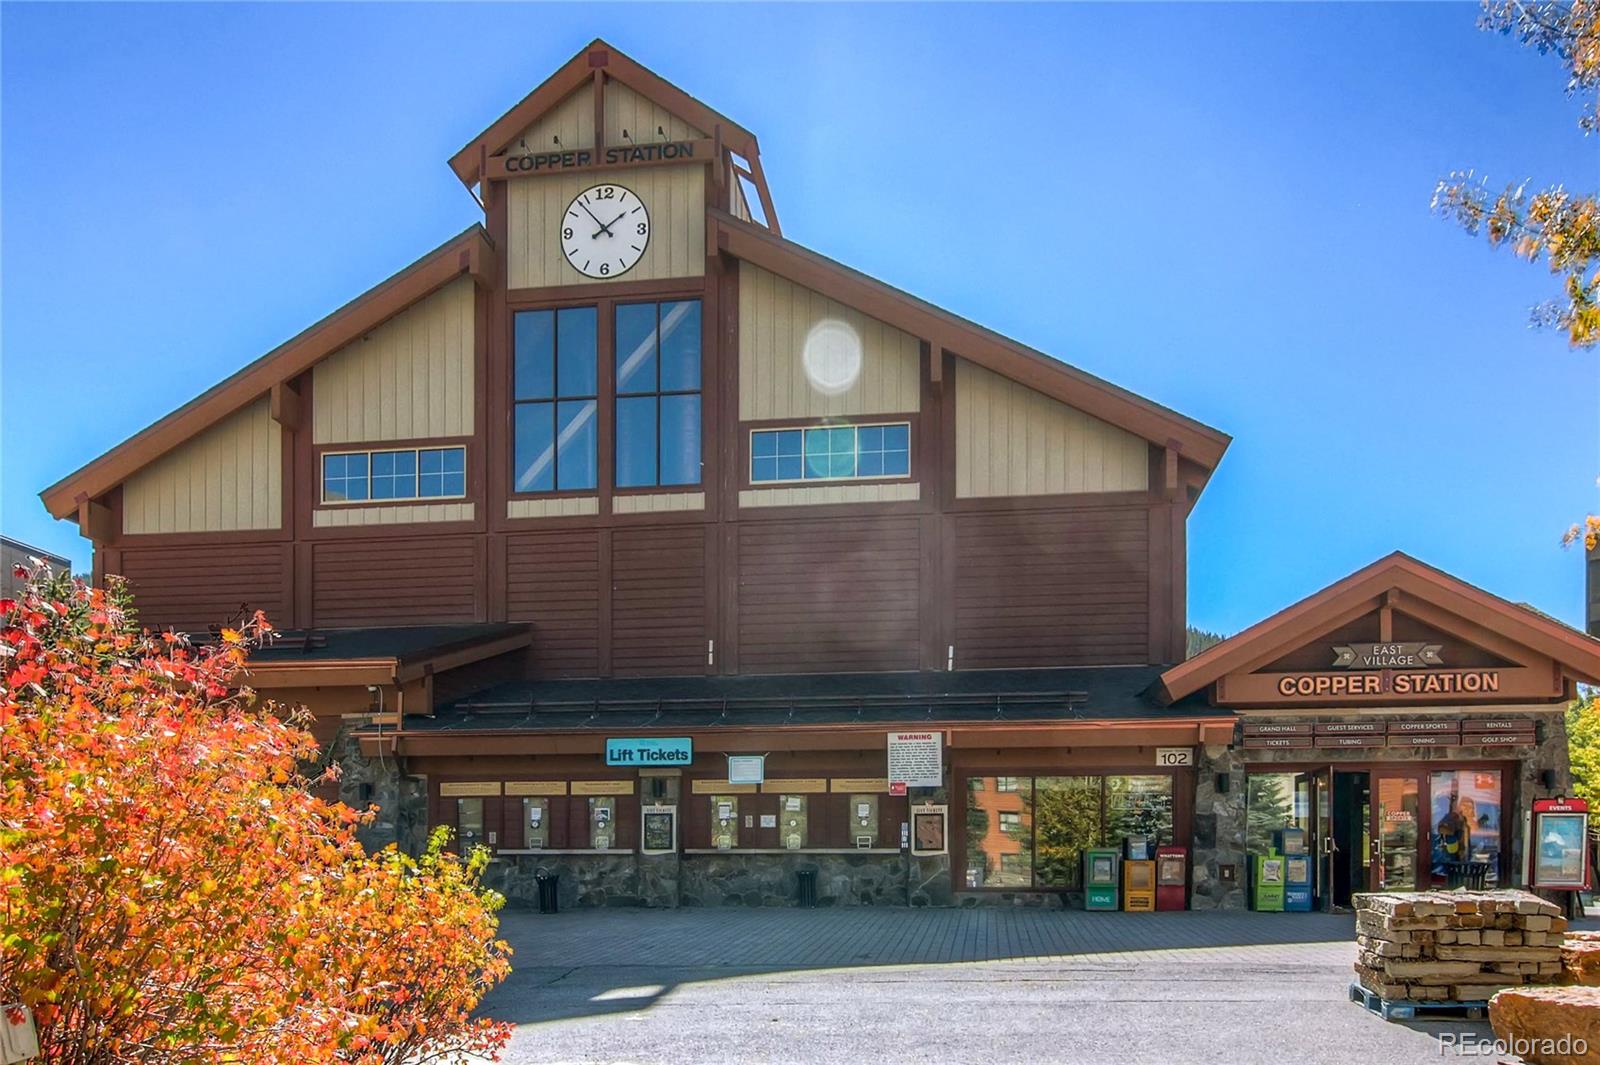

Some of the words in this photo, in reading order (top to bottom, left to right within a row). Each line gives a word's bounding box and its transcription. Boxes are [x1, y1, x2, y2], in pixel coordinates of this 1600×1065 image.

[505, 151, 591, 172] COPPER
[606, 142, 694, 164] STATION
[595, 188, 614, 200] 12
[563, 228, 574, 240] 9
[636, 223, 647, 235] 3
[600, 263, 609, 275] 6
[1373, 645, 1403, 655] EAST
[1363, 655, 1414, 666] VILLAGE
[1278, 676, 1381, 696] COPPER
[1394, 672, 1499, 694] STATION
[609, 749, 634, 761] Lift
[637, 748, 689, 761] Tickets
[1161, 753, 1188, 765] 102
